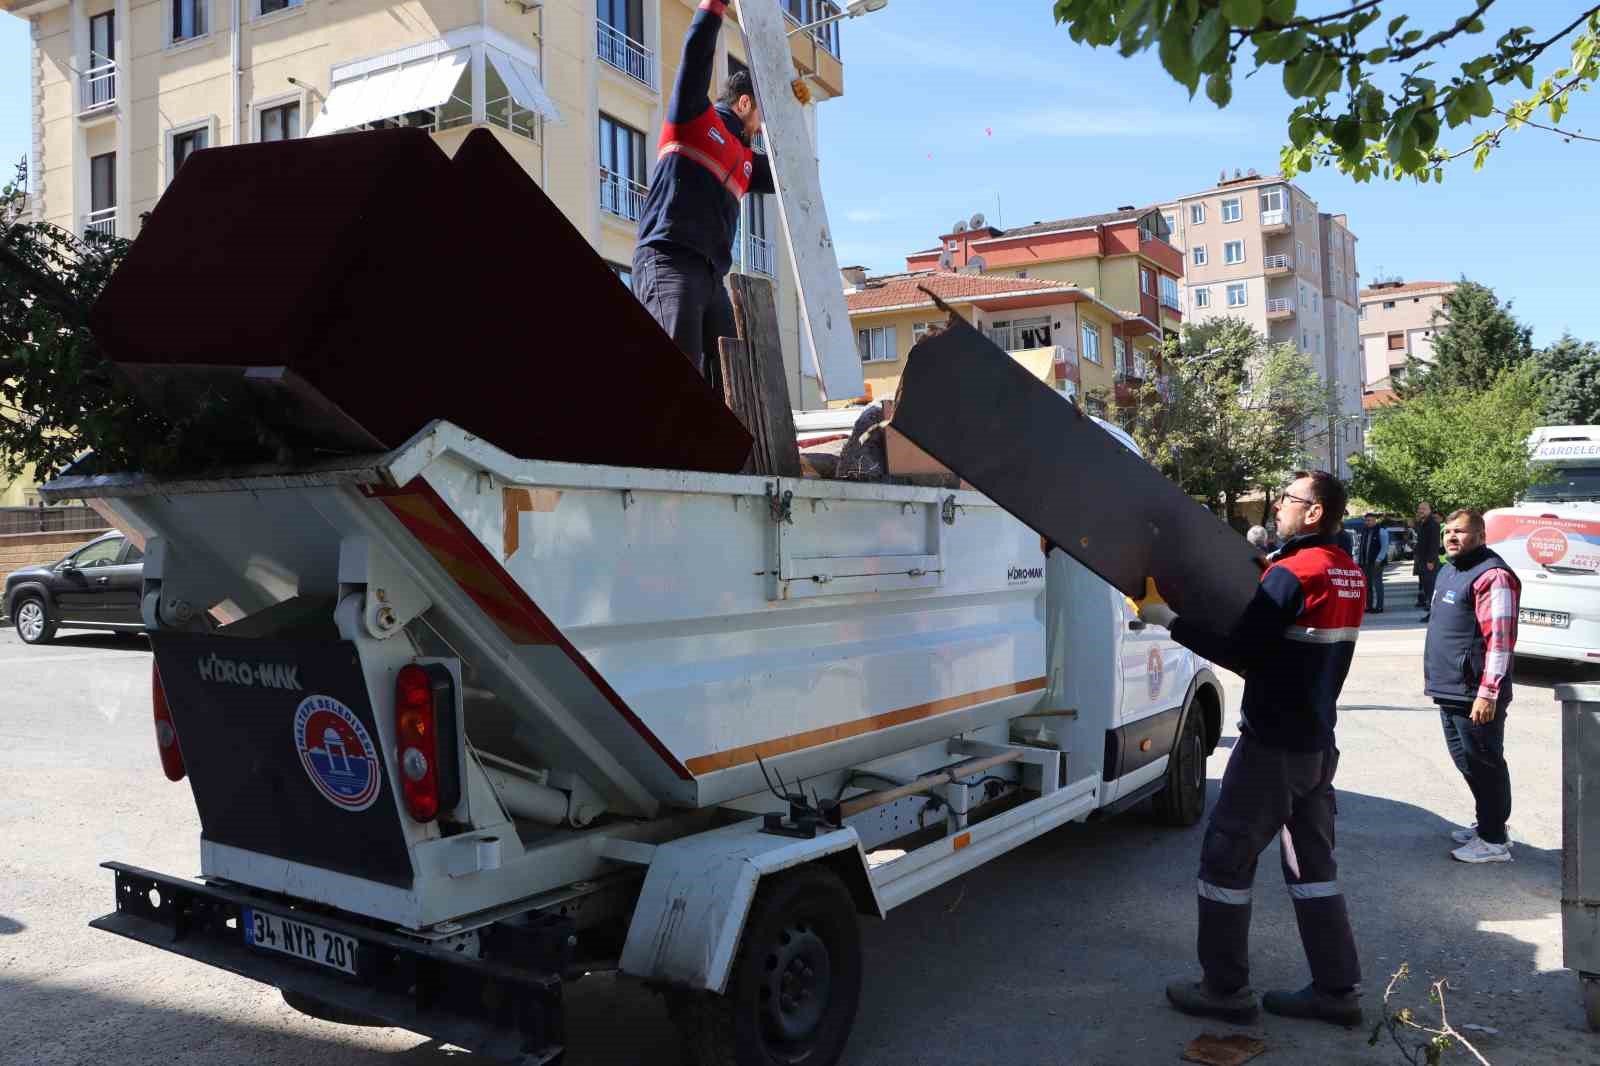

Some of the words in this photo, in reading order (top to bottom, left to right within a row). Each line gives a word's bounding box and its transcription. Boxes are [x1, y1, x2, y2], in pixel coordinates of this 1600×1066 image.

[253, 913, 276, 946] 34
[281, 920, 316, 959] NYR
[323, 932, 358, 970] 201
